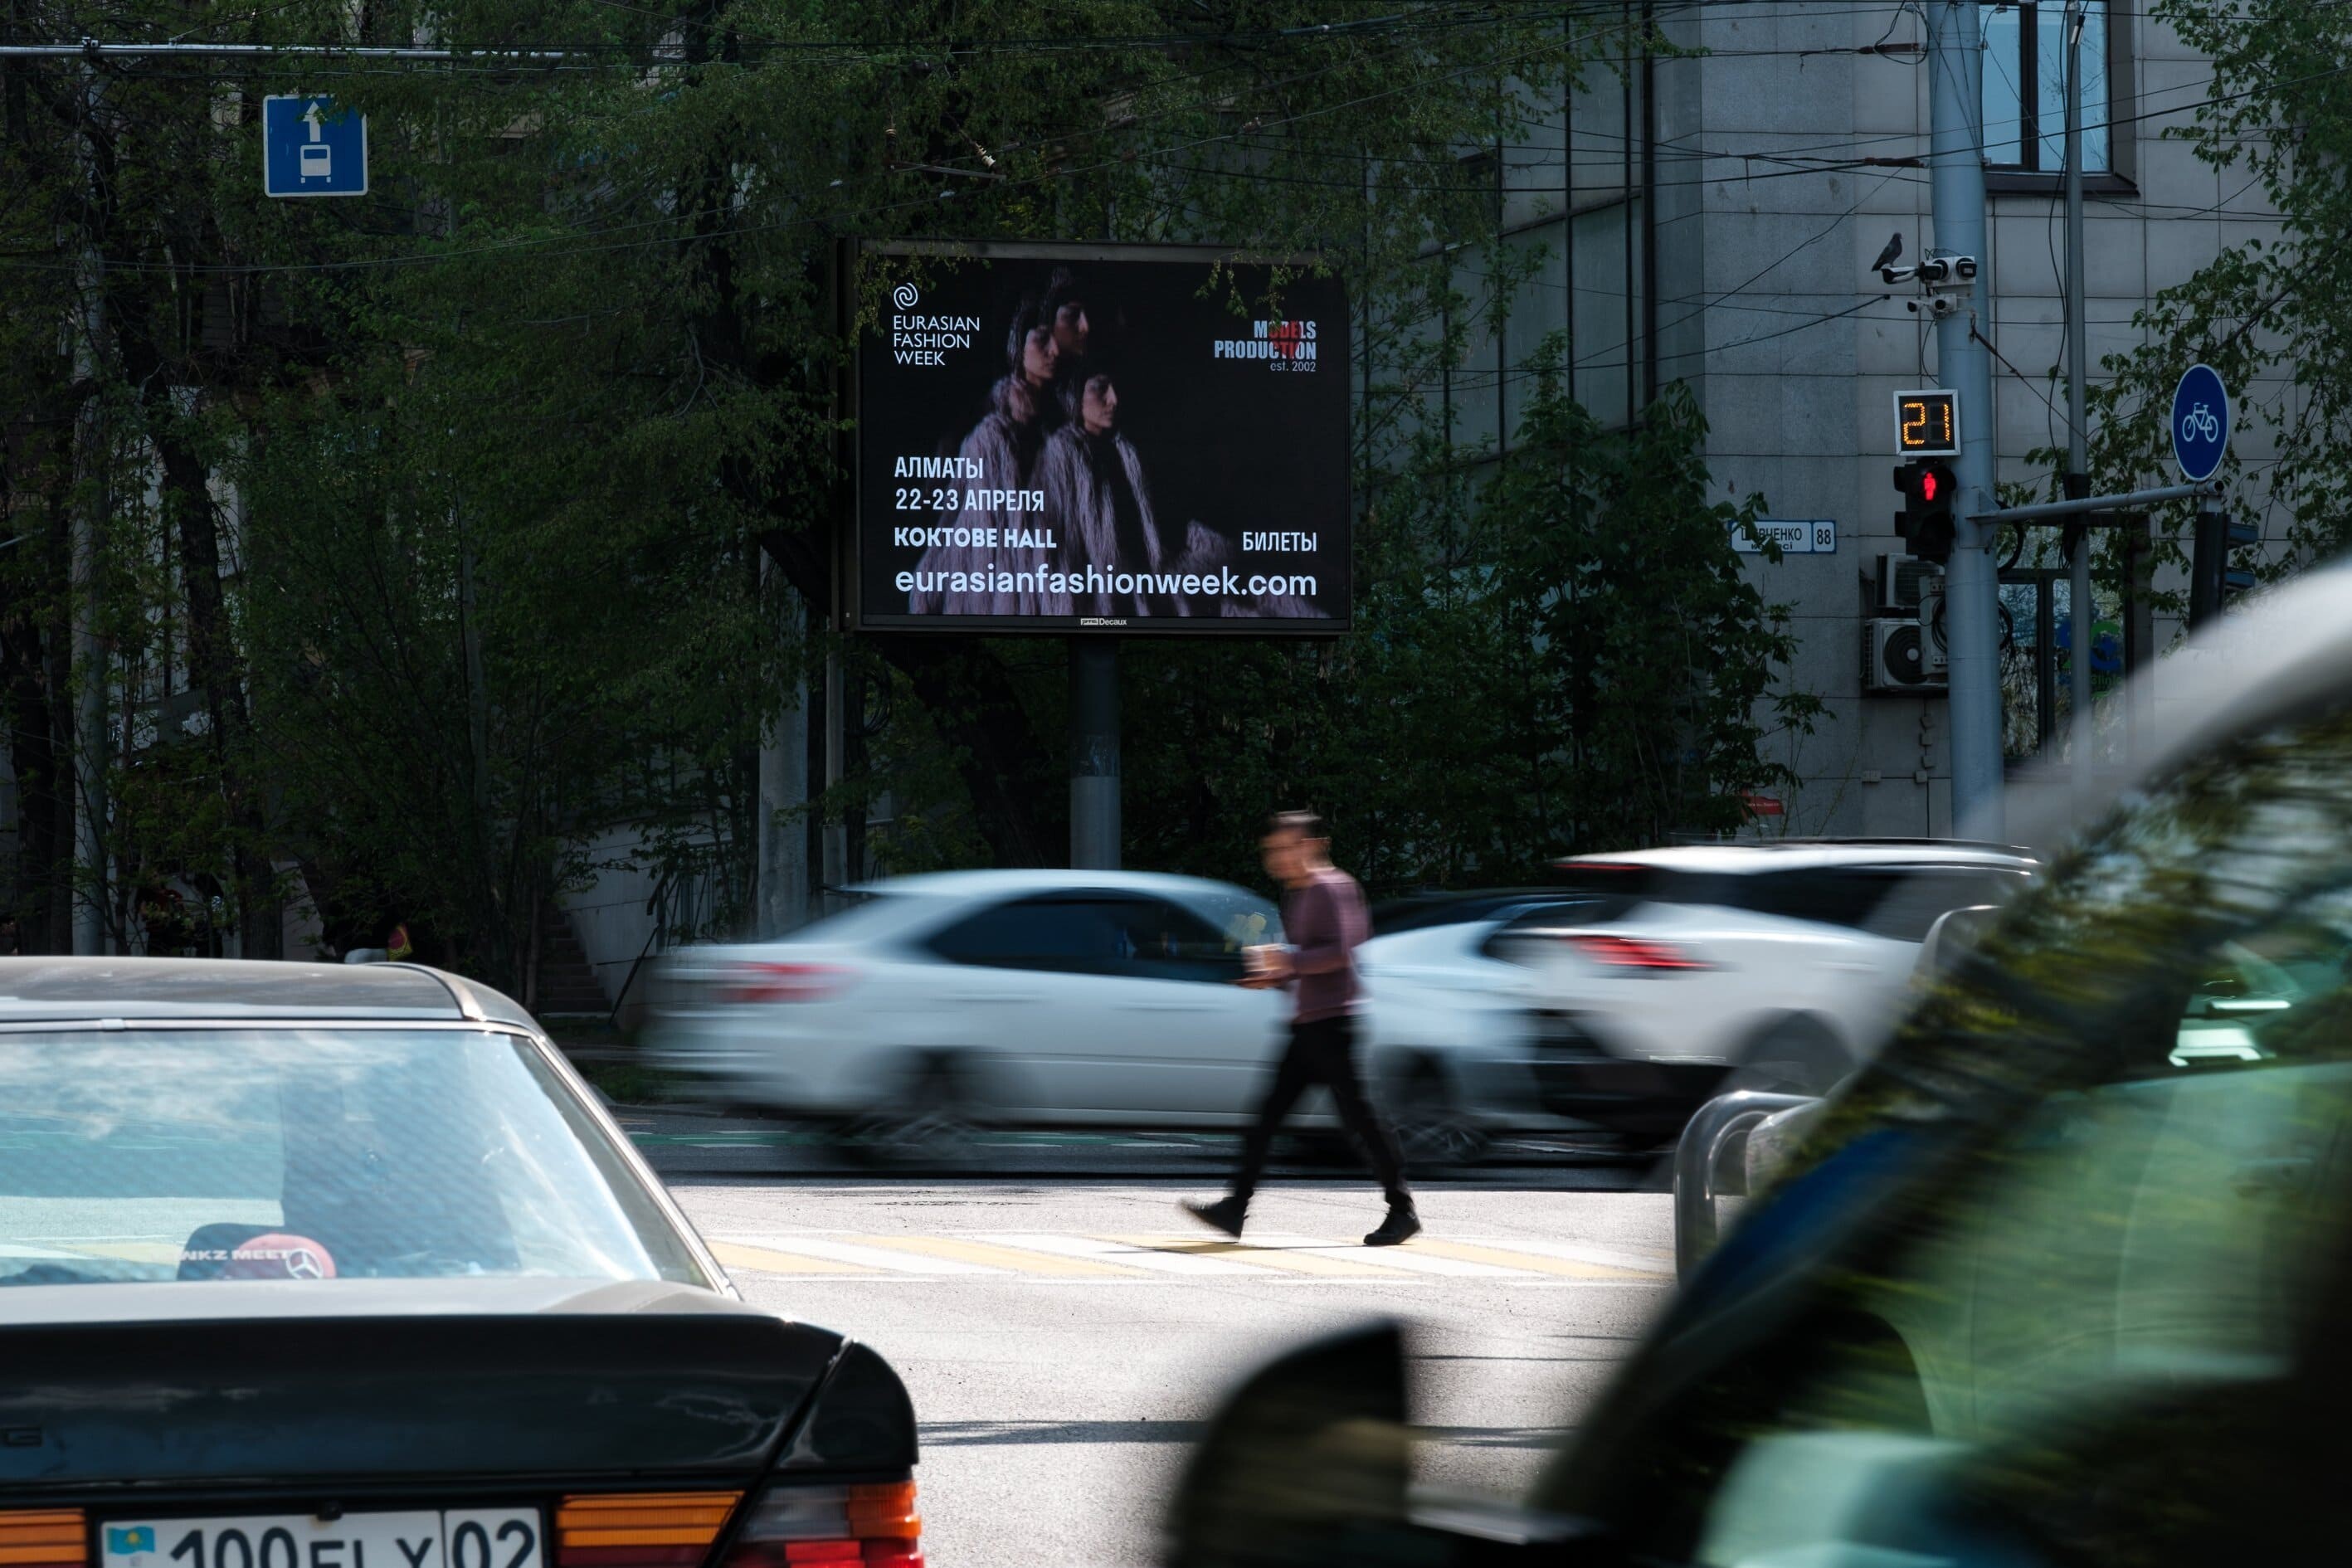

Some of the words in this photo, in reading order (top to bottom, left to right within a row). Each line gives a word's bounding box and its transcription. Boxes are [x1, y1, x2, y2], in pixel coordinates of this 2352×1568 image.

[894, 315, 980, 331] EURASIAN
[1254, 320, 1317, 338] MODELS
[894, 333, 970, 348] FASHION
[1214, 340, 1317, 359] PRODUCTION
[894, 350, 946, 366] WEEK
[1270, 361, 1289, 372] est.
[1292, 361, 1317, 372] 2002
[1903, 402, 1950, 446] 21
[894, 456, 983, 479] АЛМАТЫ
[895, 488, 959, 511] 22-23
[964, 489, 1045, 512] АПРЕЛЯ
[1004, 528, 1058, 548] HALL
[1243, 531, 1317, 552] БИЛЕТЫ
[1816, 529, 1832, 545] 88
[895, 562, 1317, 596] eurasianfashionweek.com
[452, 1520, 536, 1568] 02
